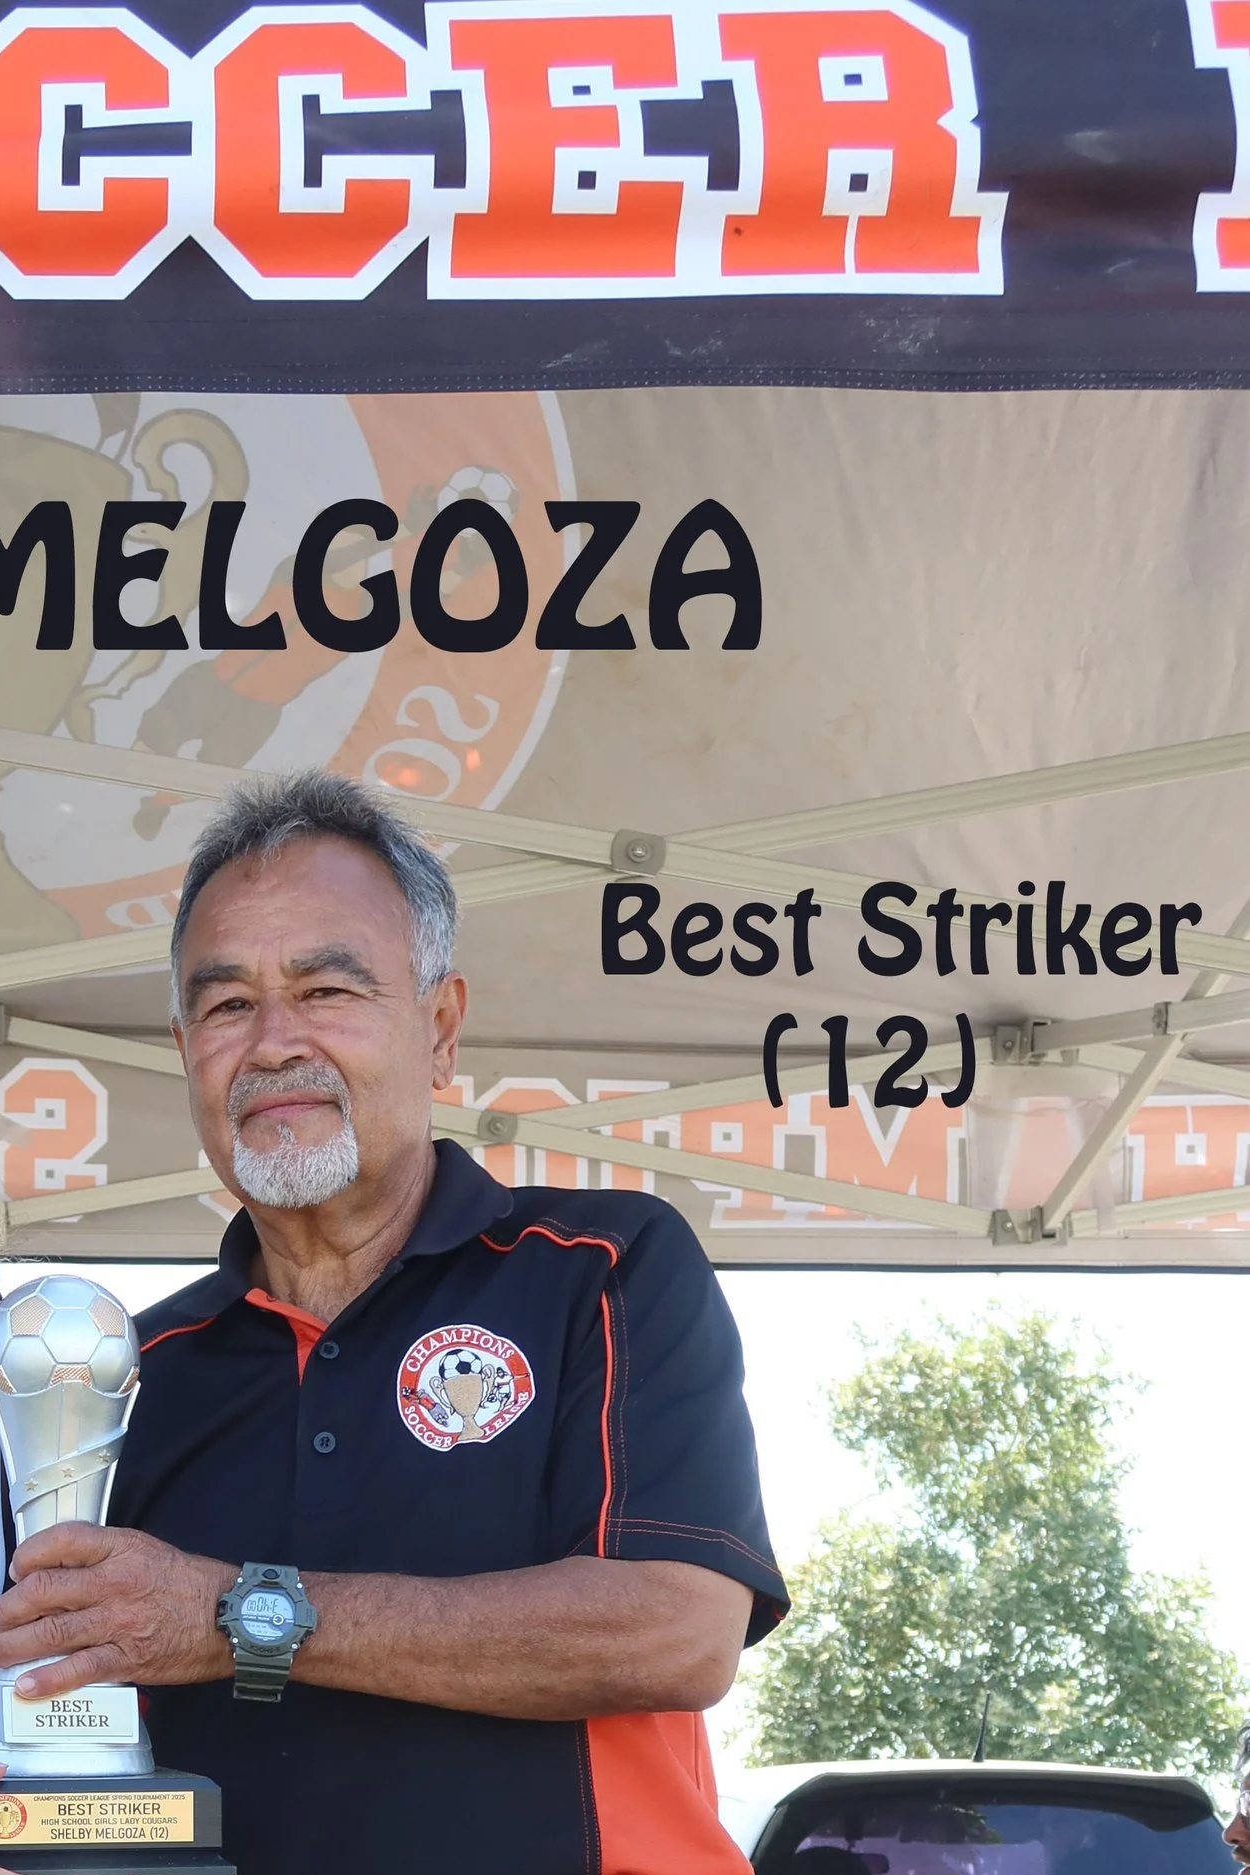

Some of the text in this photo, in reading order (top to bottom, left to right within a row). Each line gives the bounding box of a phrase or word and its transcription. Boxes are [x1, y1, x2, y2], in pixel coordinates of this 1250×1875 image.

[406, 1328, 515, 1372] CHAMPIONS
[404, 1405, 453, 1448] SOCCER
[50, 1700, 94, 1713] BEST
[35, 1714, 111, 1728] STRIKER
[57, 1802, 161, 1816] BEST STRIKER
[41, 1818, 60, 1826] HIGH
[94, 1817, 118, 1825] GIRLS
[119, 1817, 140, 1825] LADY
[50, 1826, 170, 1841] SHELBY MELGOZA (12)
